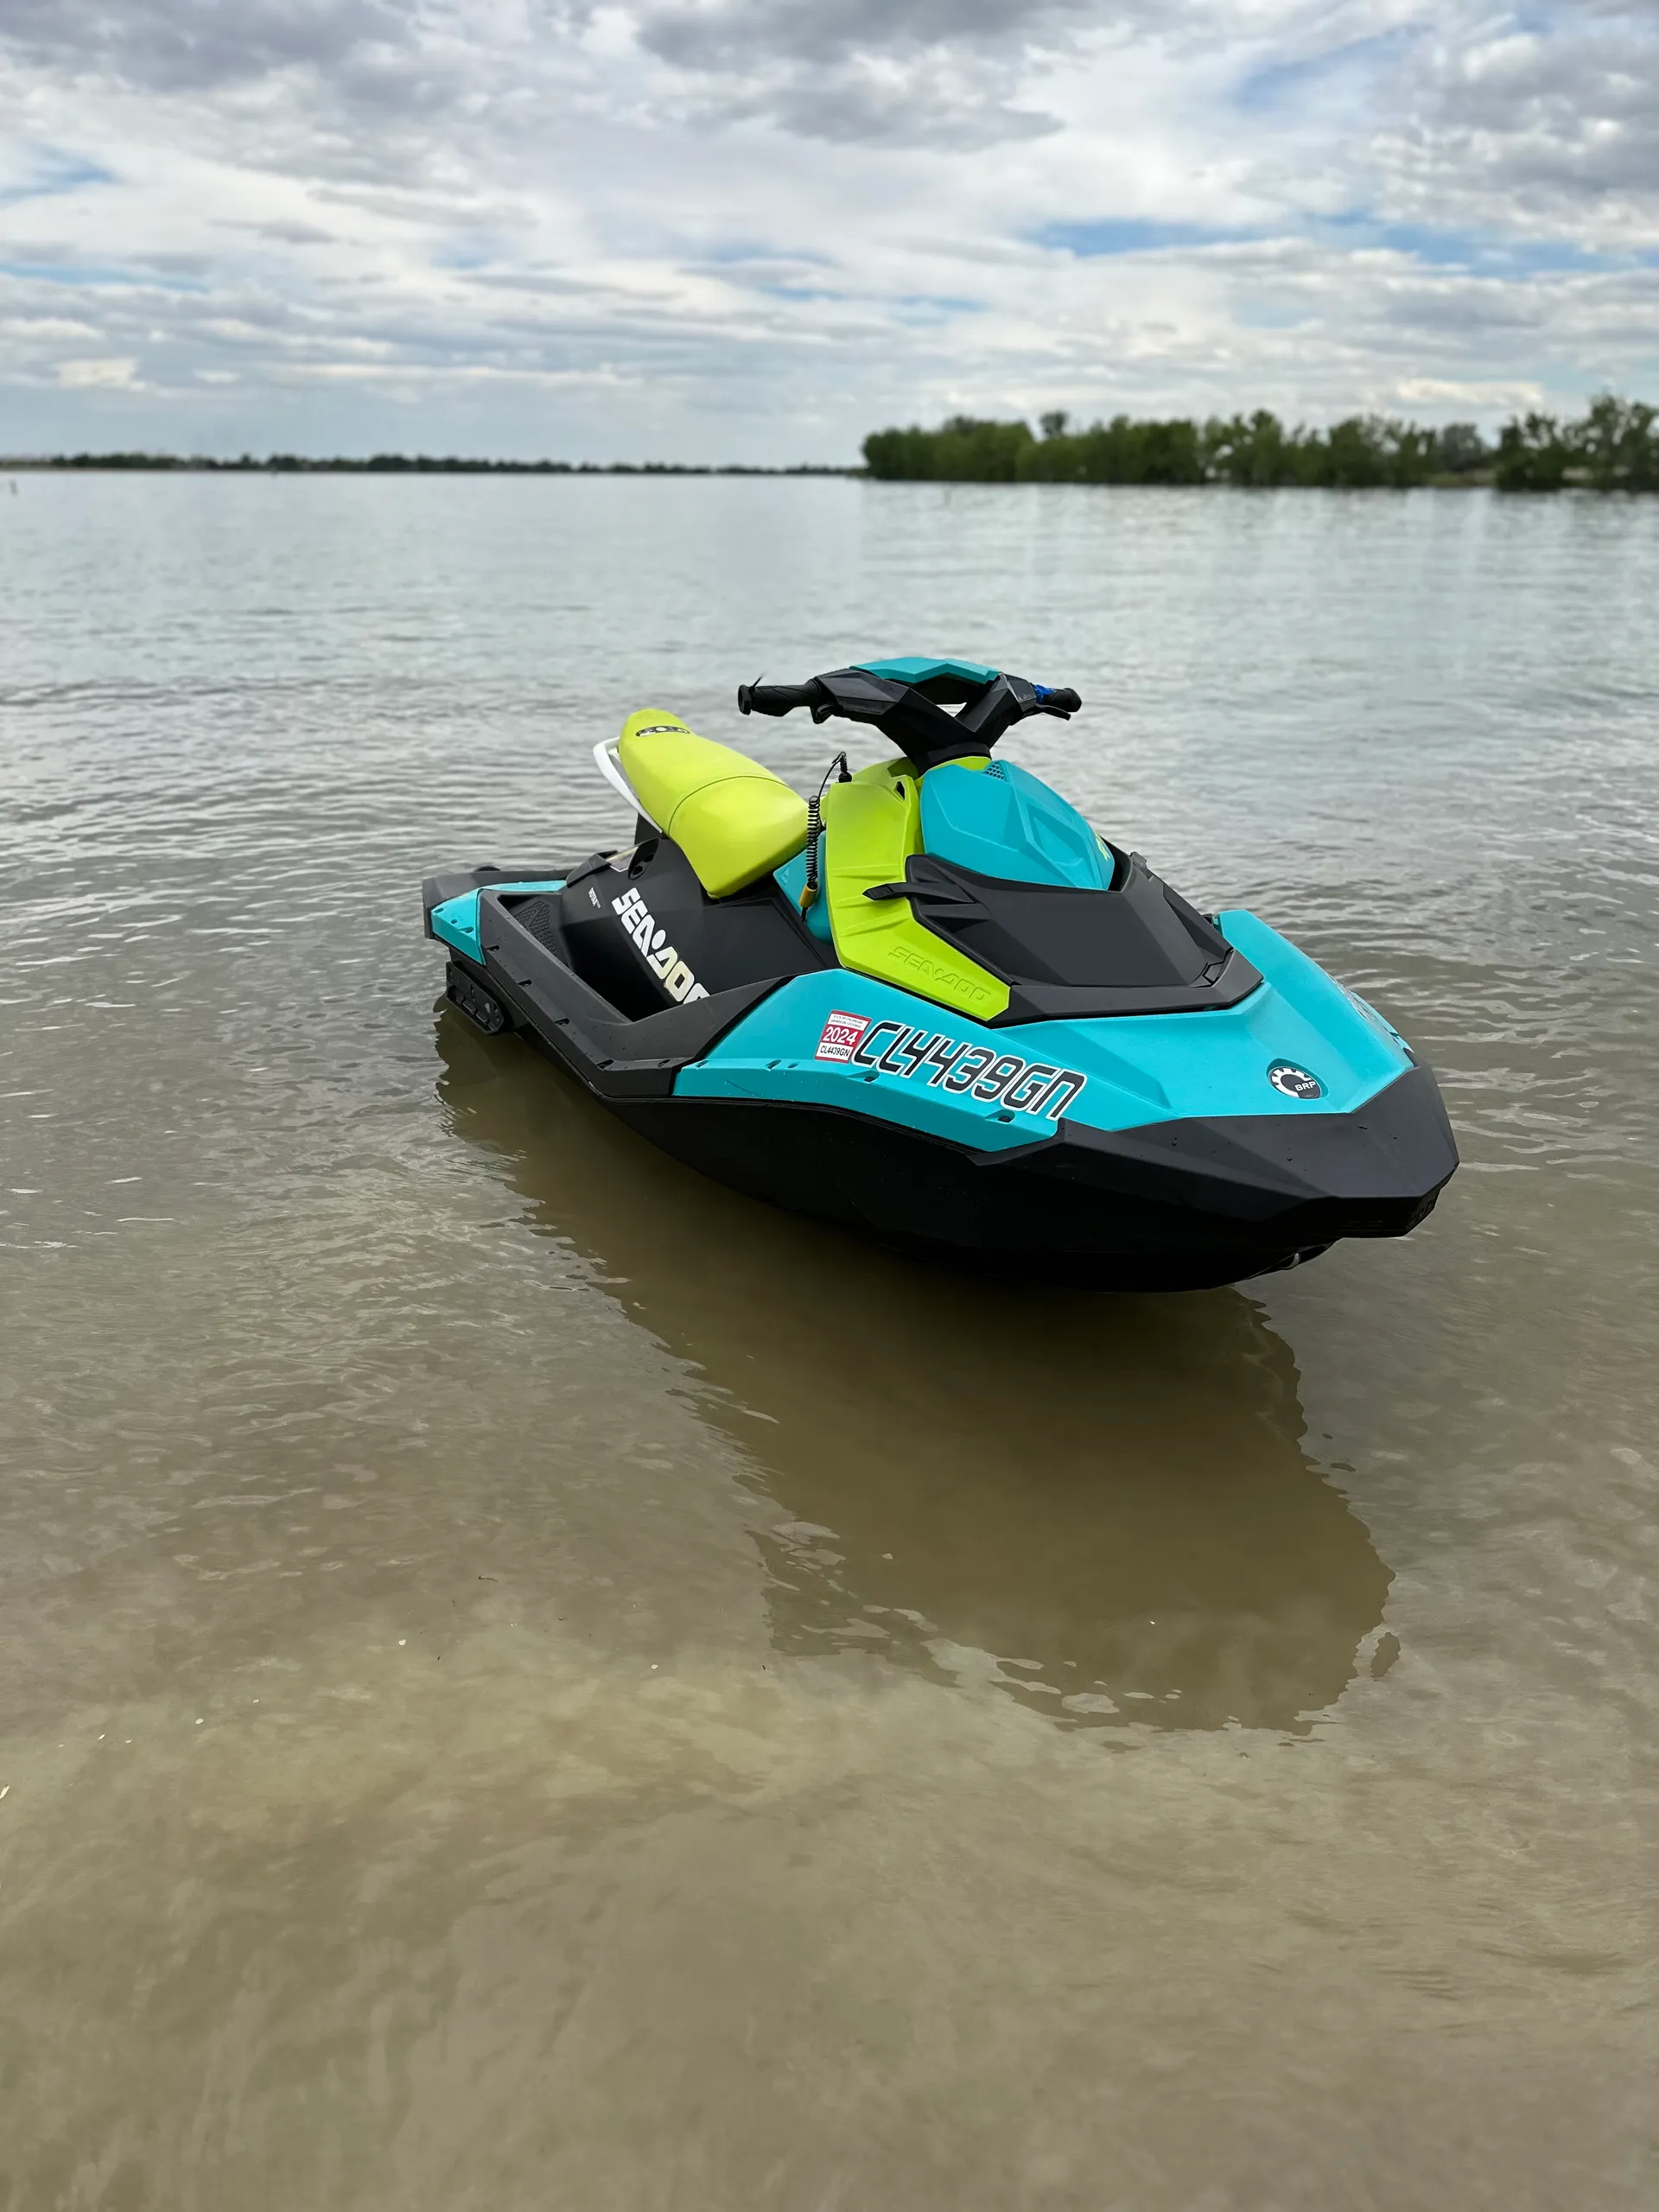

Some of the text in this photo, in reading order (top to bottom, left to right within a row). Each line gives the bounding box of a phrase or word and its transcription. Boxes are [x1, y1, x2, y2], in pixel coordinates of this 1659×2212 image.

[823, 1026, 859, 1045] 2024
[820, 1045, 851, 1057] CL4439GN
[852, 1020, 1087, 1121] CL4439GN
[1294, 1081, 1317, 1092] BRP
